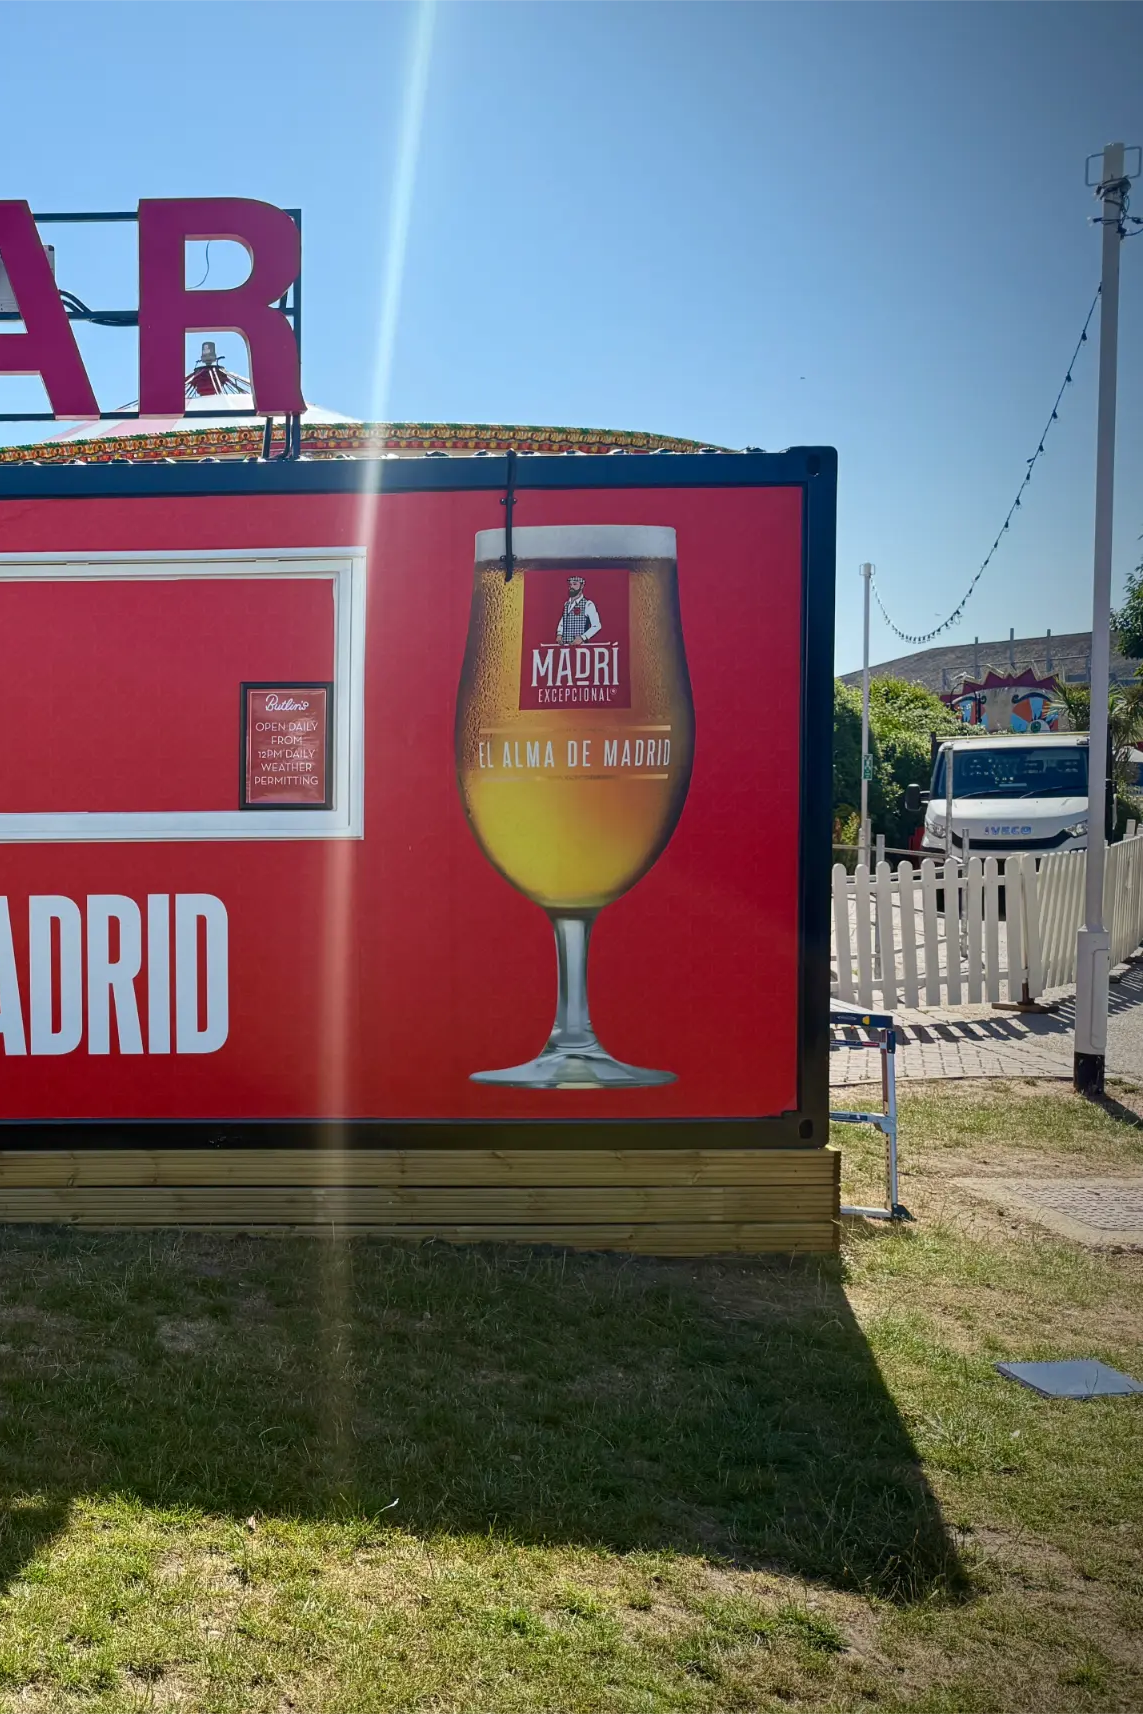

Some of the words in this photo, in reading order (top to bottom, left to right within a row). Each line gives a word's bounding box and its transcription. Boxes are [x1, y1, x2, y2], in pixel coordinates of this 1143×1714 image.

[531, 641, 620, 687] MADRÍ
[265, 693, 309, 712] Butlin's
[255, 722, 286, 732] OPEN
[288, 721, 319, 732] DAILY
[271, 735, 303, 745] FROM
[258, 749, 283, 759] 12PM
[285, 748, 316, 759] DAILY
[478, 742, 494, 769] EL
[502, 740, 555, 768] ALMA
[567, 740, 592, 768] DE
[603, 738, 671, 767] MADRID
[260, 762, 312, 772] WEATHER
[254, 776, 319, 786] PERMITTING
[984, 825, 1032, 836] IVECO
